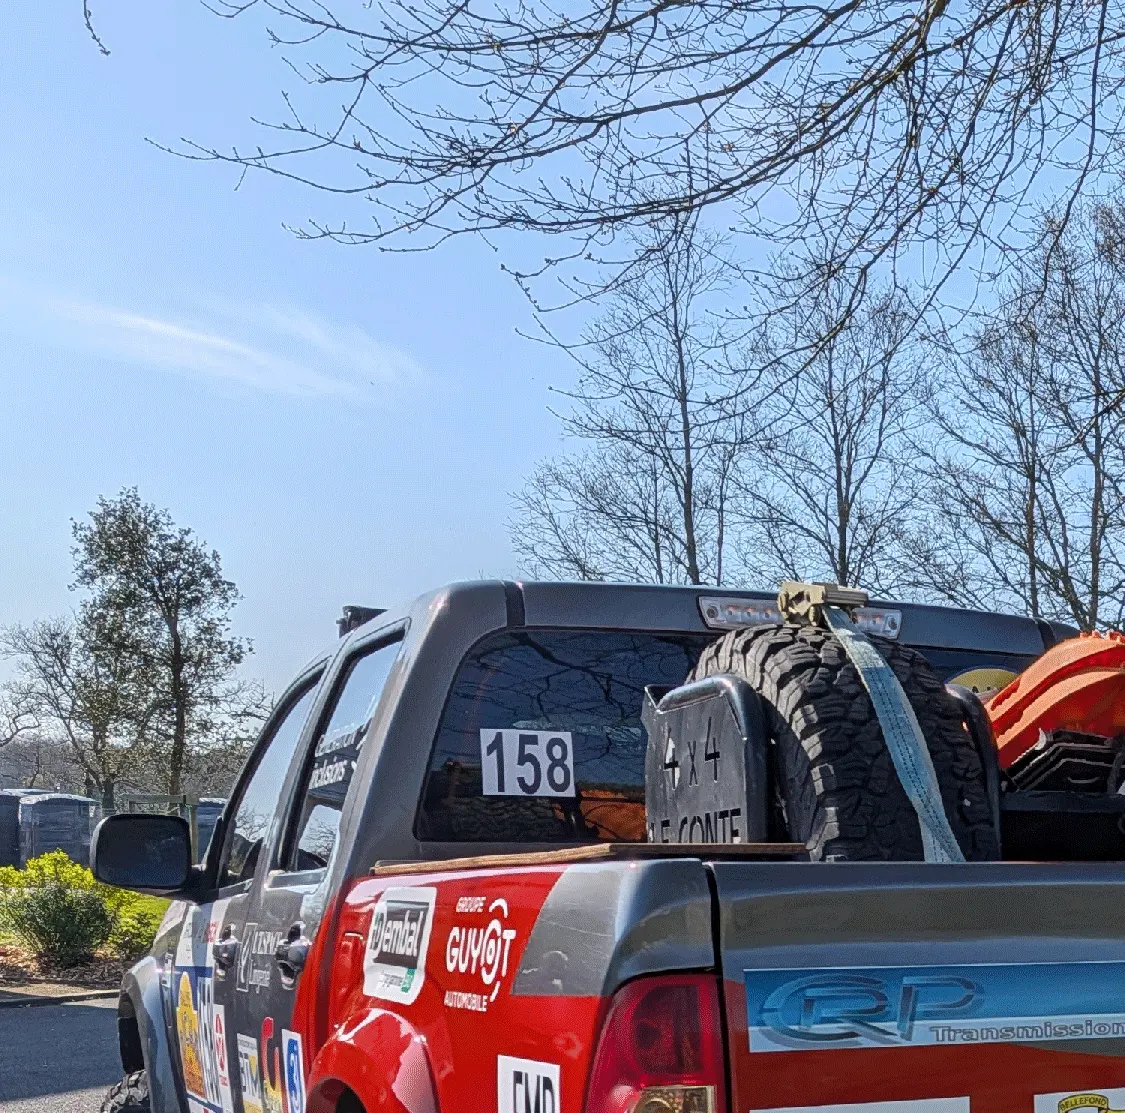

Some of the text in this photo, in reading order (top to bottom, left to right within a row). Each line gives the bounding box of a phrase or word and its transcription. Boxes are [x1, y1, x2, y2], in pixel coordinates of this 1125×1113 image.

[486, 731, 571, 795] 158
[444, 990, 489, 1012] AUTOMOBILE
[1060, 1096, 1106, 1110] BELLEFOND
